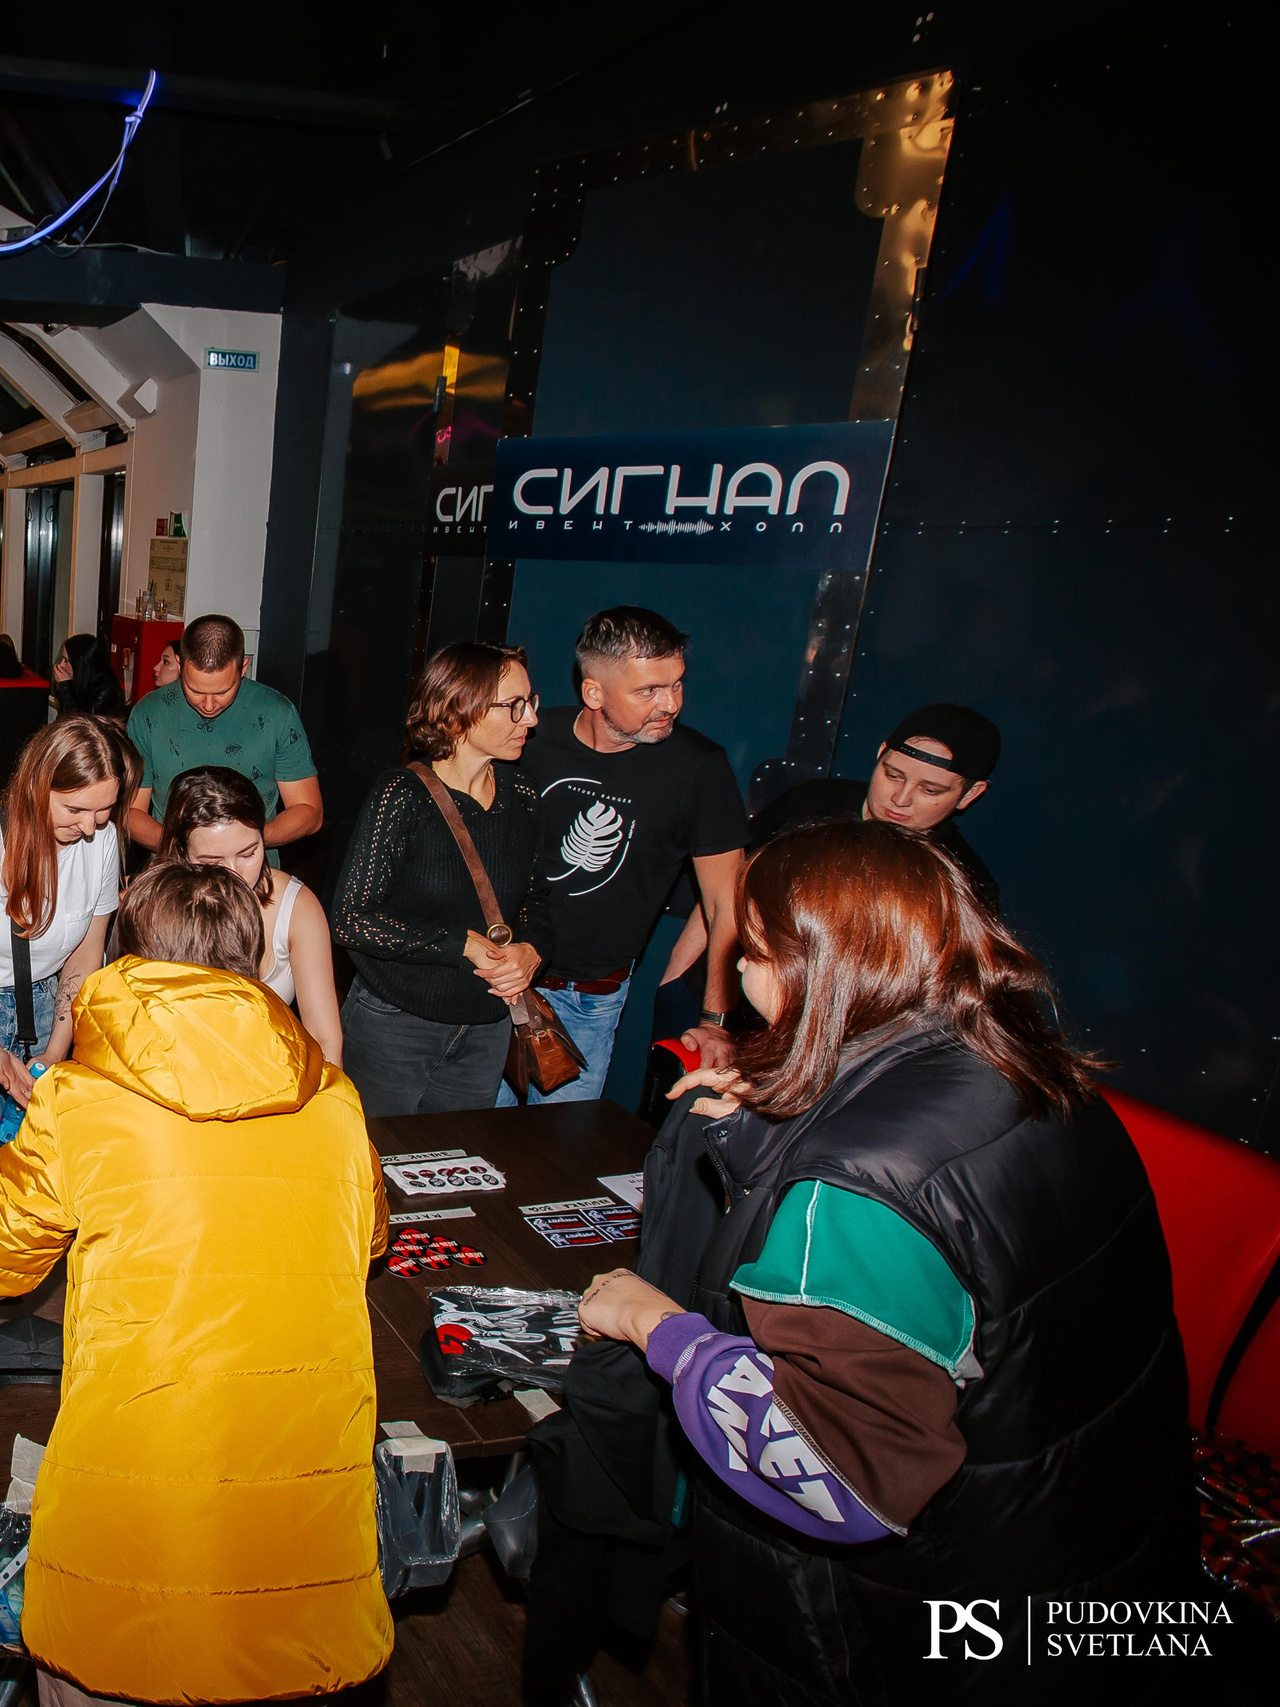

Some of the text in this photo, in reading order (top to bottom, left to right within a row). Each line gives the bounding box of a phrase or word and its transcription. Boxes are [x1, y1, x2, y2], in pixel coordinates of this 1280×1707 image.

[209, 352, 254, 369] ВЫХОД
[513, 461, 850, 516] СИГНАЛ
[508, 519, 634, 531] ИВЕНТ
[567, 784, 632, 804] NATURE RANGER
